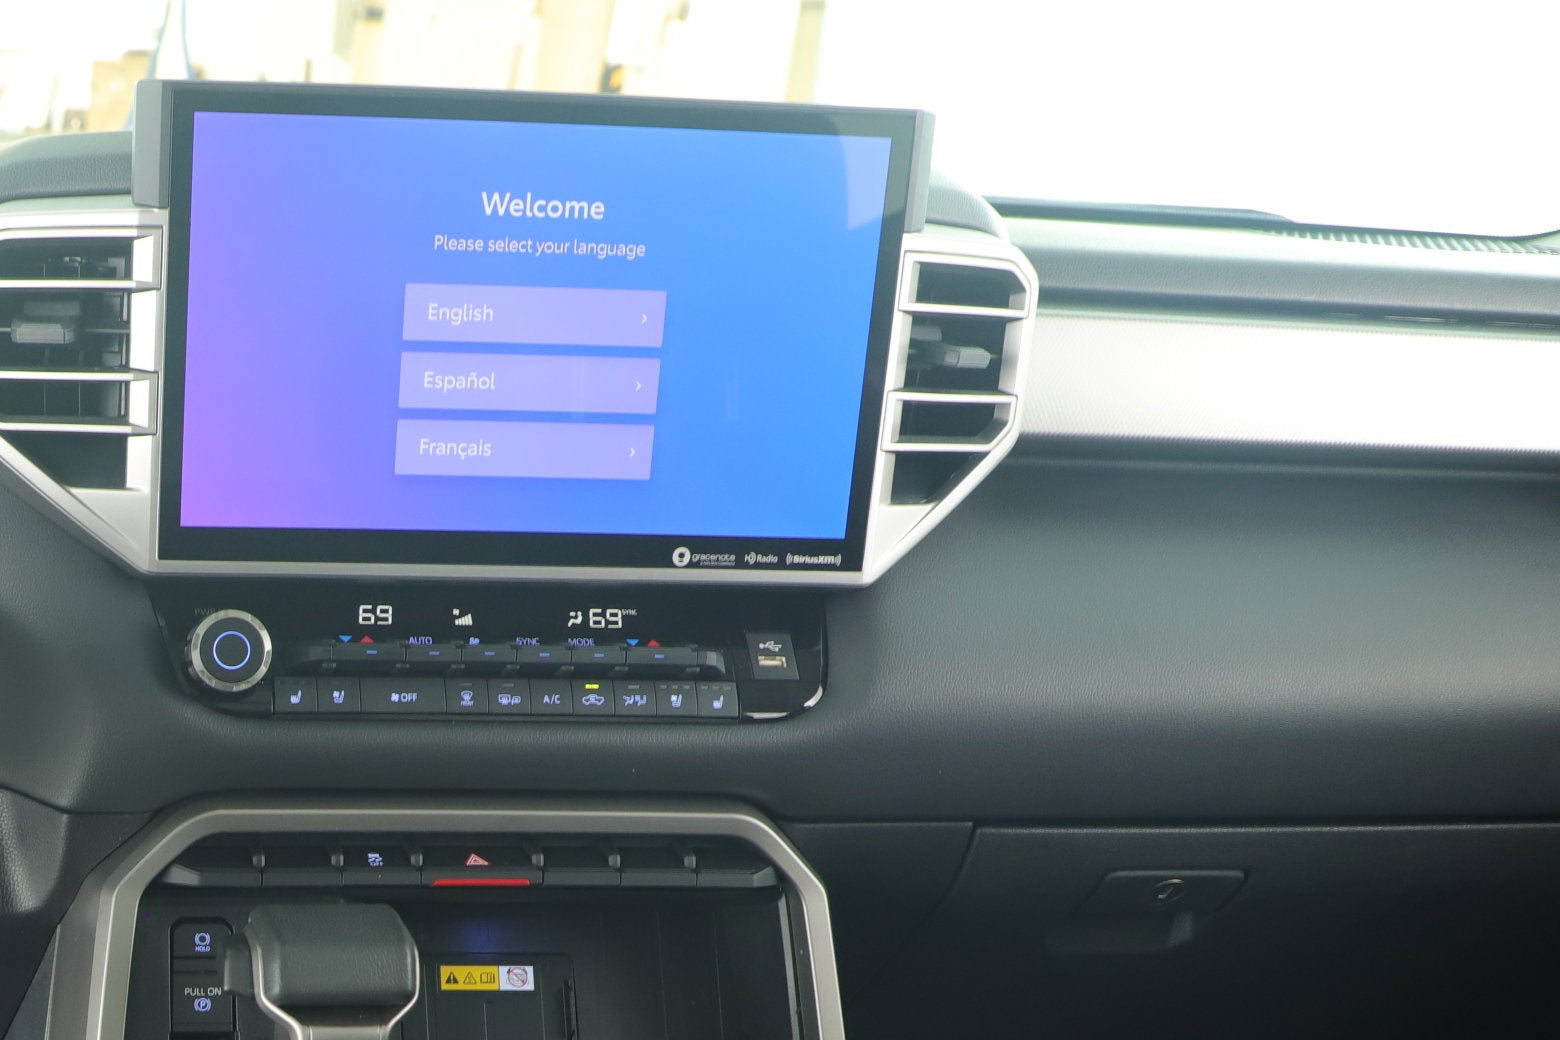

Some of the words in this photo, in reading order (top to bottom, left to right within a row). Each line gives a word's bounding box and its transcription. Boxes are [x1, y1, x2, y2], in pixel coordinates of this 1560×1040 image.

[481, 191, 606, 220] Welcome
[434, 235, 484, 252] Please
[487, 236, 533, 254] select
[536, 240, 570, 257] your
[573, 239, 646, 260] language
[427, 303, 494, 326] English
[423, 371, 496, 392] Español
[419, 438, 492, 460] Français
[692, 553, 736, 563] gracenote
[757, 553, 779, 565] Radio
[358, 605, 393, 625] 69
[588, 608, 623, 629] 69
[408, 636, 433, 645] AUTO
[515, 637, 540, 647] SYNC
[567, 637, 595, 647] MODE
[400, 692, 417, 703] OFF
[543, 694, 561, 705] A/C
[195, 945, 211, 953] HOLD
[184, 987, 206, 997] PULL
[207, 986, 222, 996] ON
